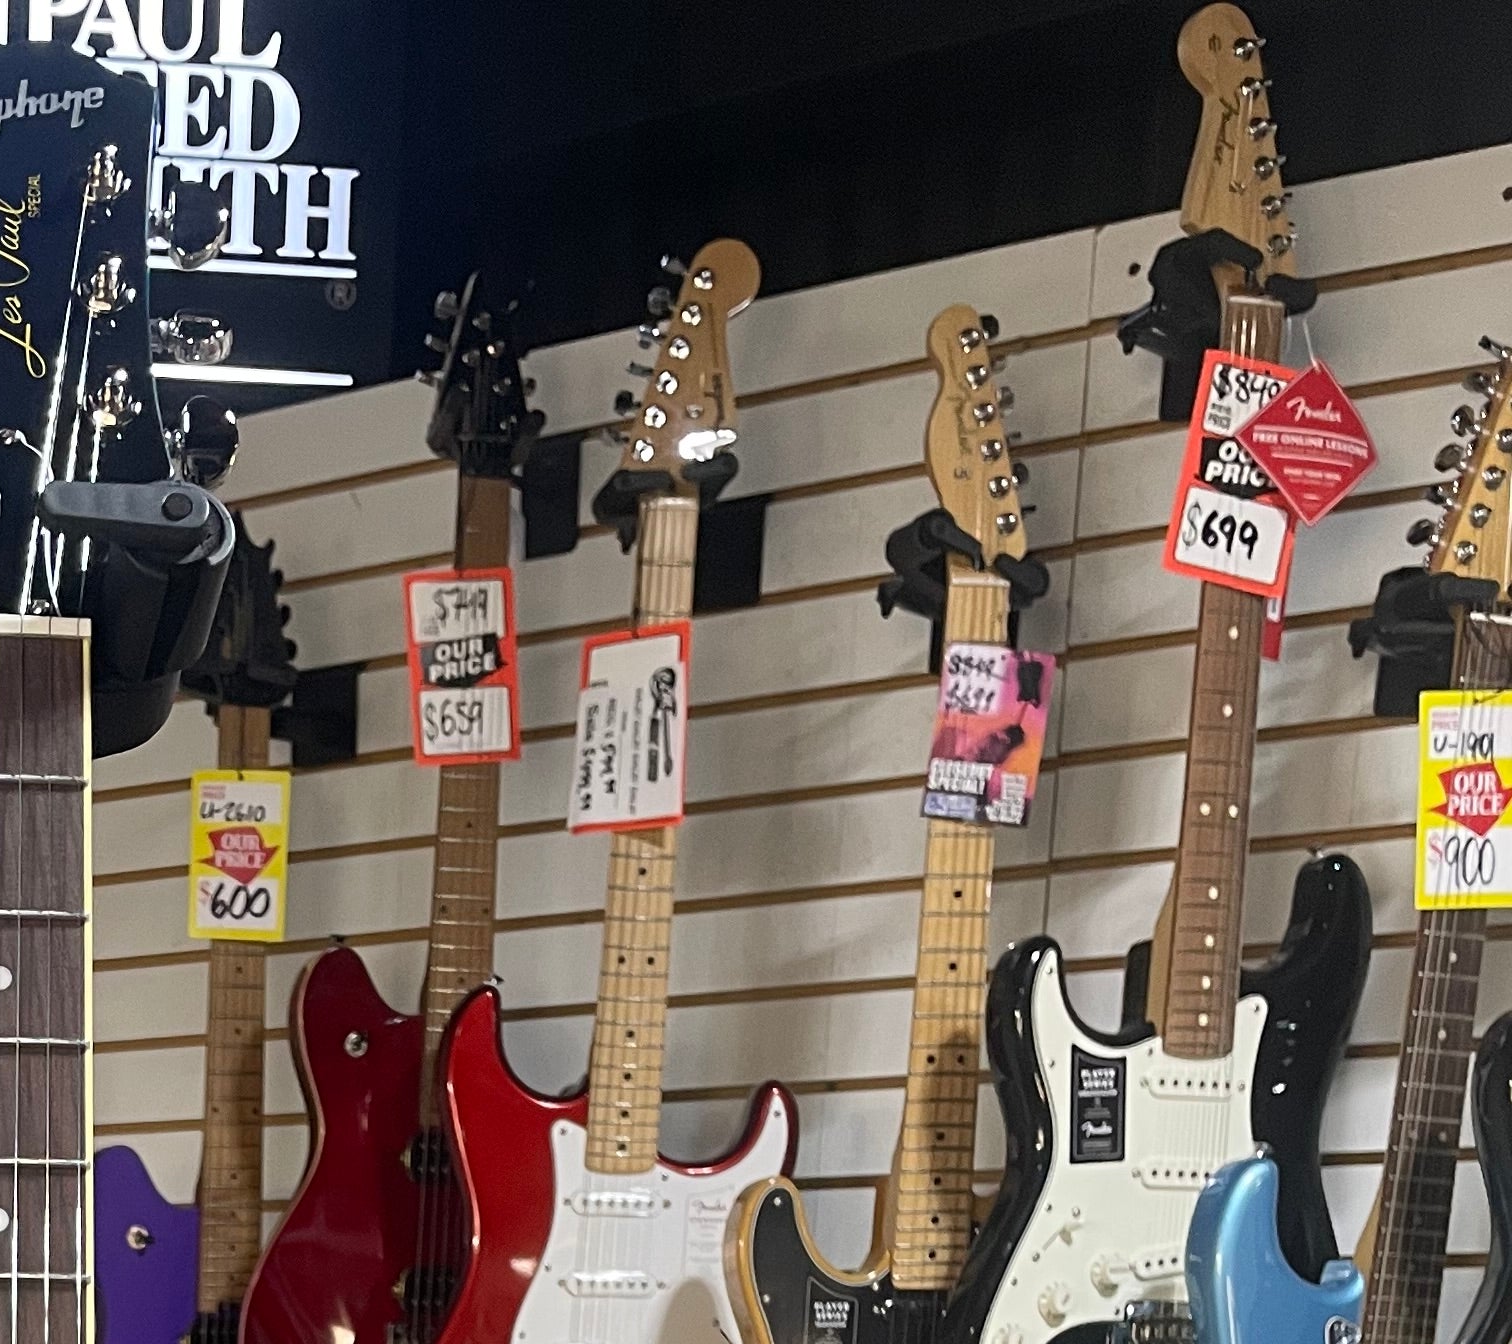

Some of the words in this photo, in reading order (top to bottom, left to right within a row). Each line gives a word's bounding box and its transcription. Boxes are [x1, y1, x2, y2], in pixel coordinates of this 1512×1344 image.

[26, 173, 42, 220] SPECIAL
[1287, 396, 1342, 423] Fender
[1205, 461, 1272, 489] PRIC
[1181, 501, 1260, 560] $699
[434, 637, 484, 663] OUR
[428, 651, 498, 684] PRICE
[423, 698, 484, 743] $659
[1453, 770, 1497, 793] OUR
[1447, 791, 1504, 817] PRICE
[220, 833, 260, 850] OUR
[215, 850, 267, 869] PRICE
[1428, 832, 1496, 889] $900
